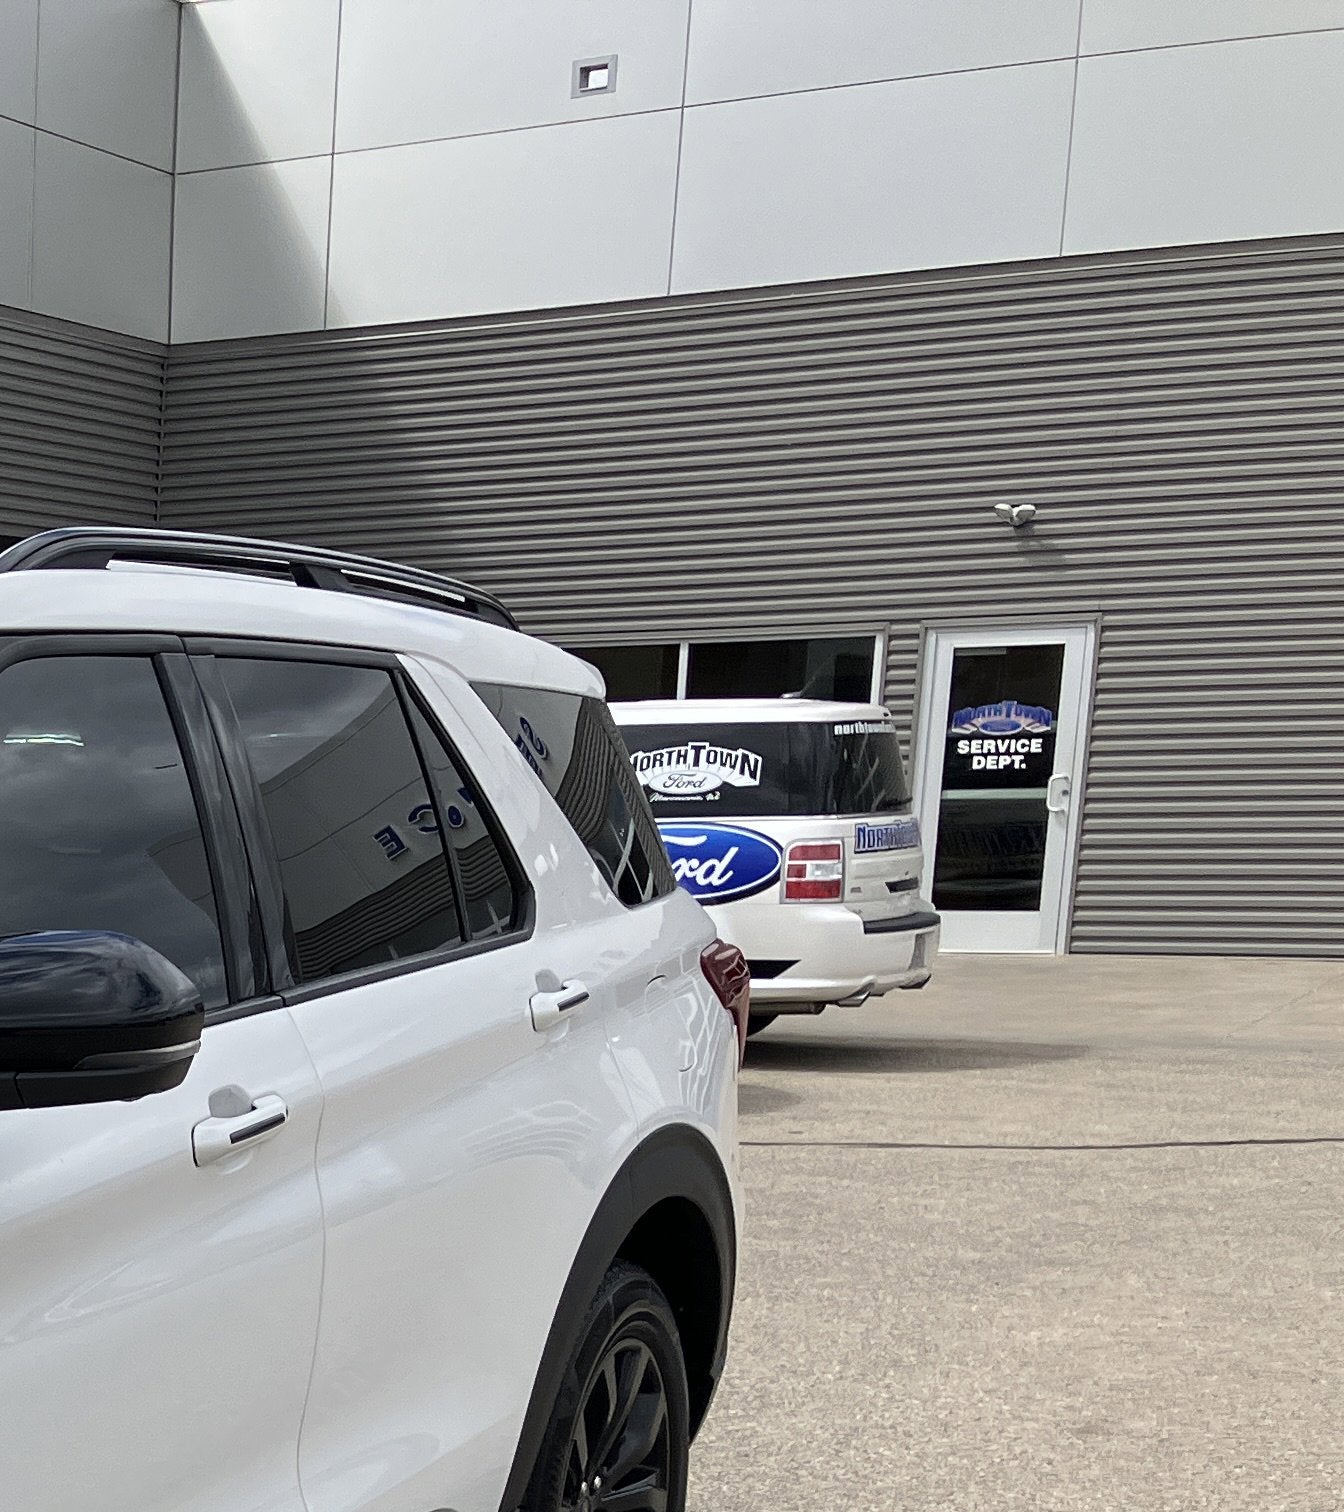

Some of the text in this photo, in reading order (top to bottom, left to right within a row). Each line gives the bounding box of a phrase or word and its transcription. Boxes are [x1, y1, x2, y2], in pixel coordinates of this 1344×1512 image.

[957, 738, 1043, 754] SERVICE
[972, 755, 1026, 770] DEPT.
[663, 773, 707, 789] Ford
[661, 834, 739, 887] rd
